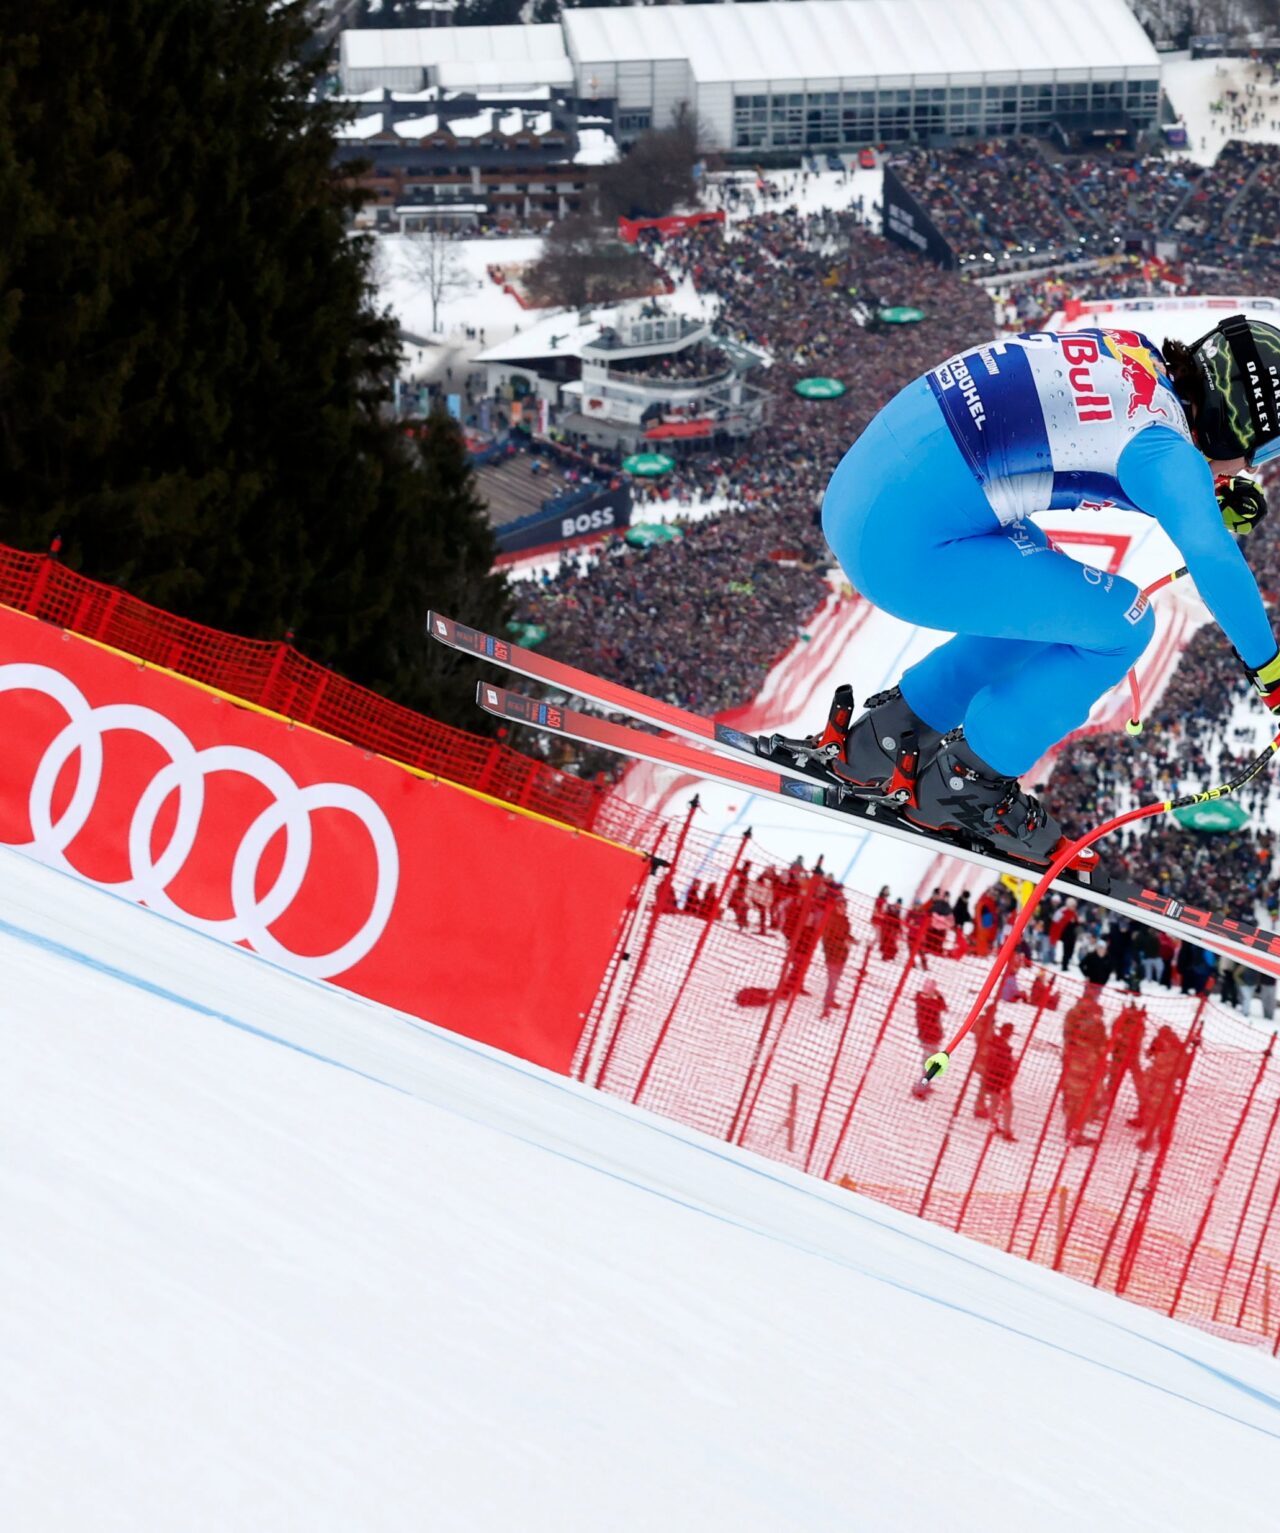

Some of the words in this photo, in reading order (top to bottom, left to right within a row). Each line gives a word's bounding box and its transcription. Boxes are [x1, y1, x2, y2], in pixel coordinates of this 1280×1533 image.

[1061, 340, 1112, 421] Bull
[1247, 361, 1271, 432] OAKLEY
[562, 507, 614, 537] BOSS
